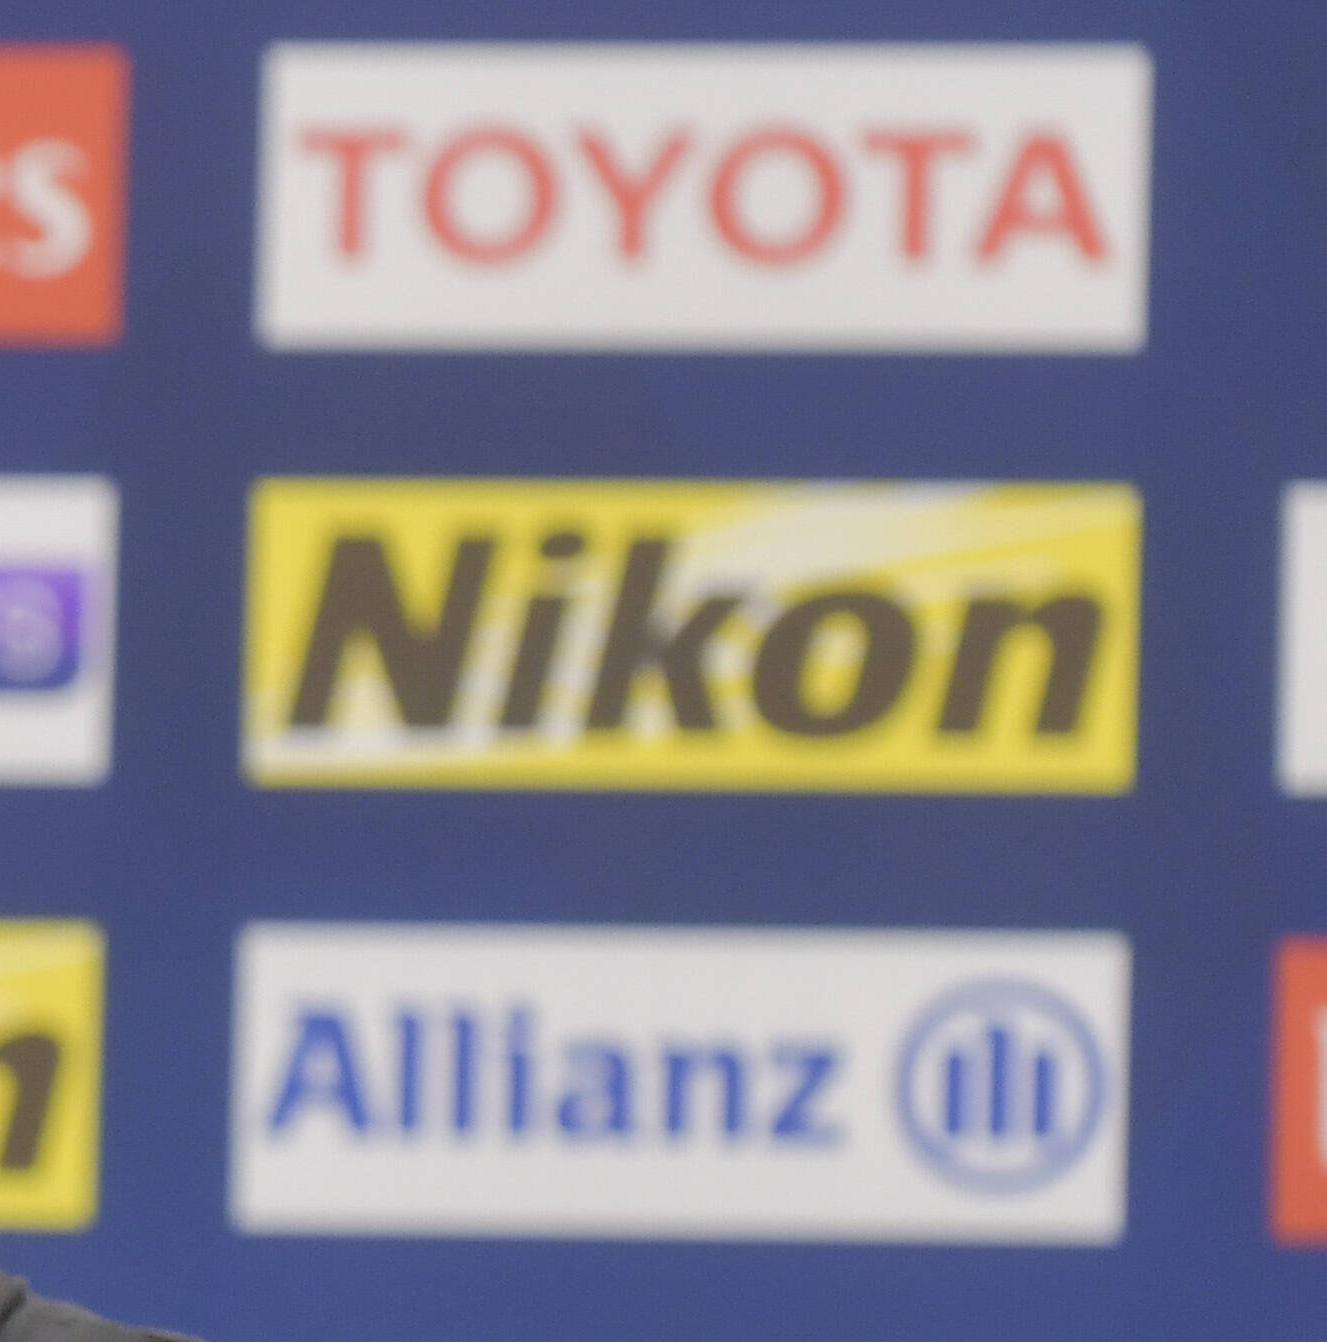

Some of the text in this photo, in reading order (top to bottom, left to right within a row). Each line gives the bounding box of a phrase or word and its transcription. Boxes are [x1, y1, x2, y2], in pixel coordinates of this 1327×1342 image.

[297, 127, 1107, 266] TOYOTA
[287, 530, 1104, 738] Nikon
[268, 1008, 840, 1138] Allianz
